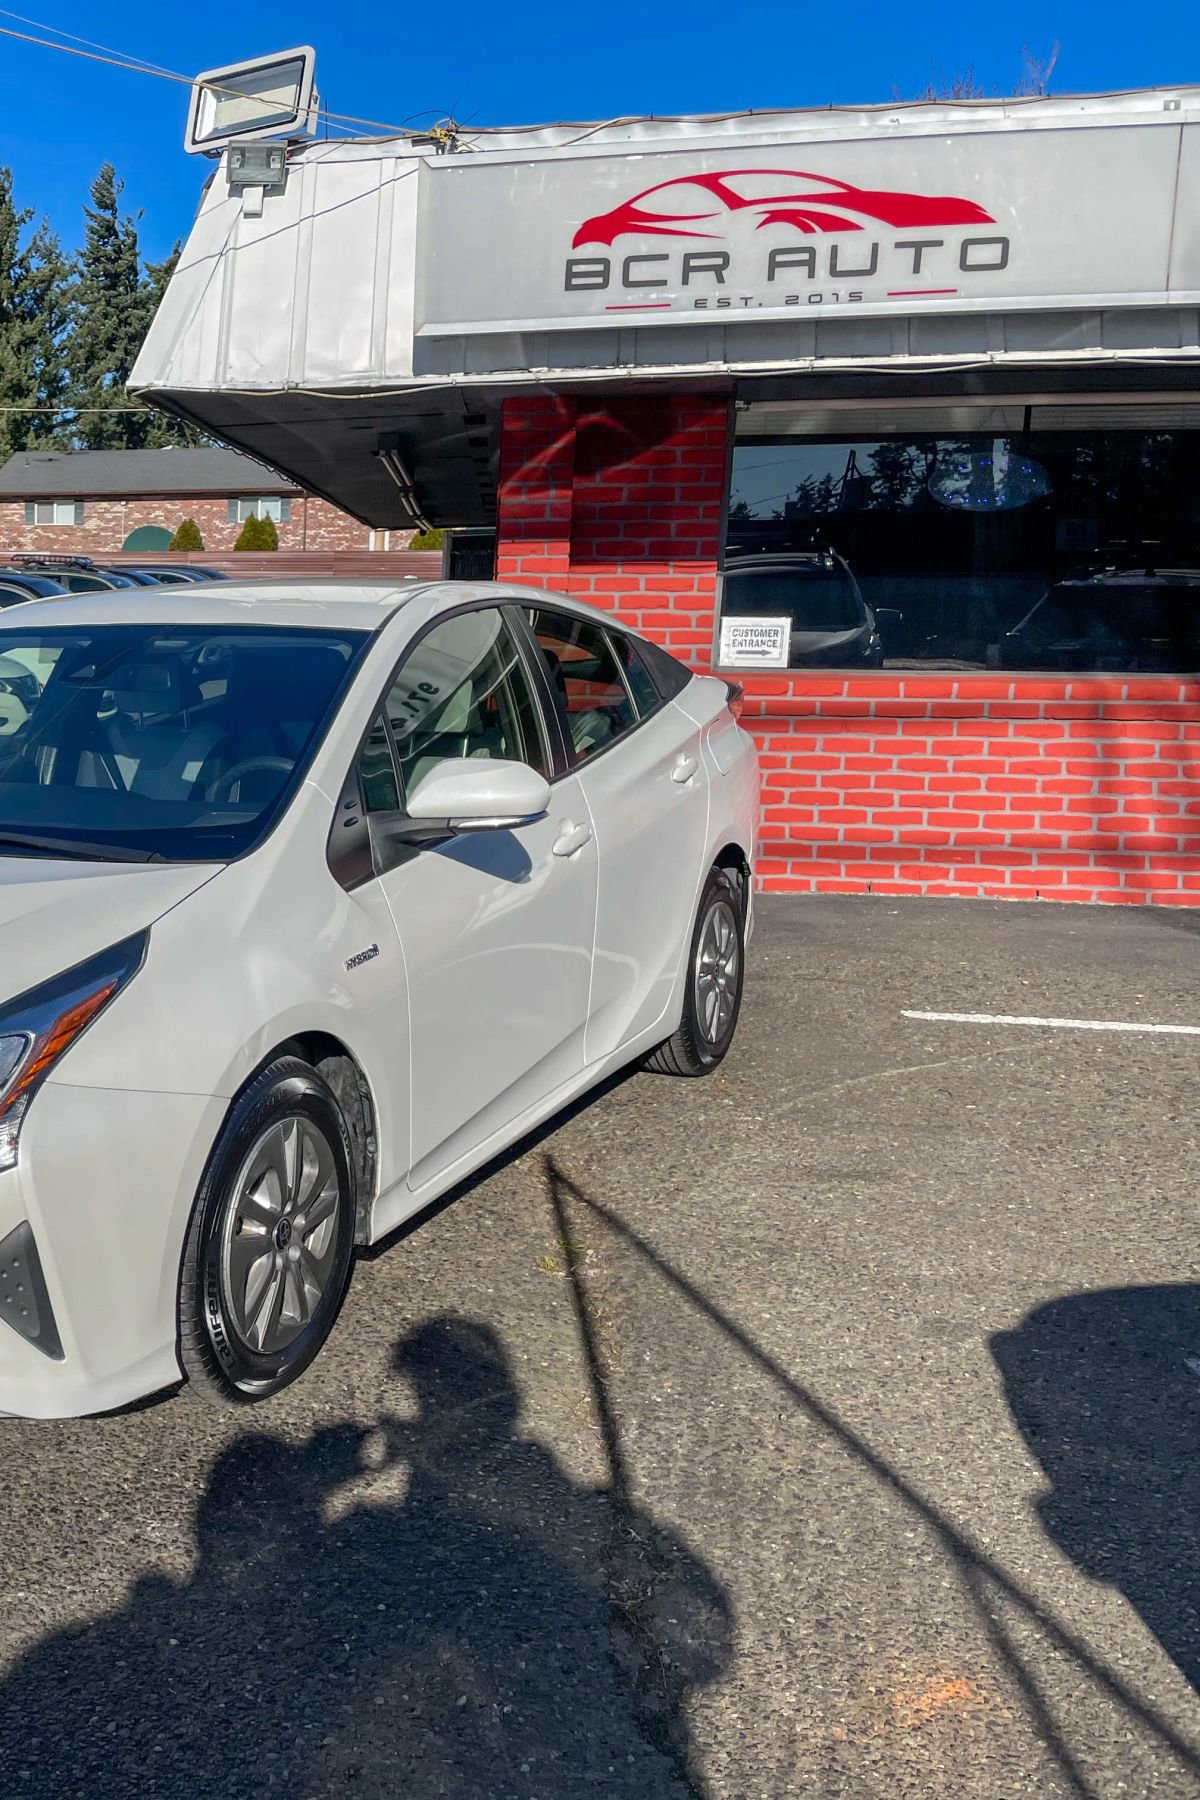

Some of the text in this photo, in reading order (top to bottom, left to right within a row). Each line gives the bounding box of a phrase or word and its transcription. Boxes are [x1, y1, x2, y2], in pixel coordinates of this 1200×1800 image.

[564, 236, 1010, 291] BCR AUTO
[694, 292, 864, 309] EST. 2015
[732, 628, 780, 638] CUSTOMER
[732, 639, 778, 648] ENTRANCE
